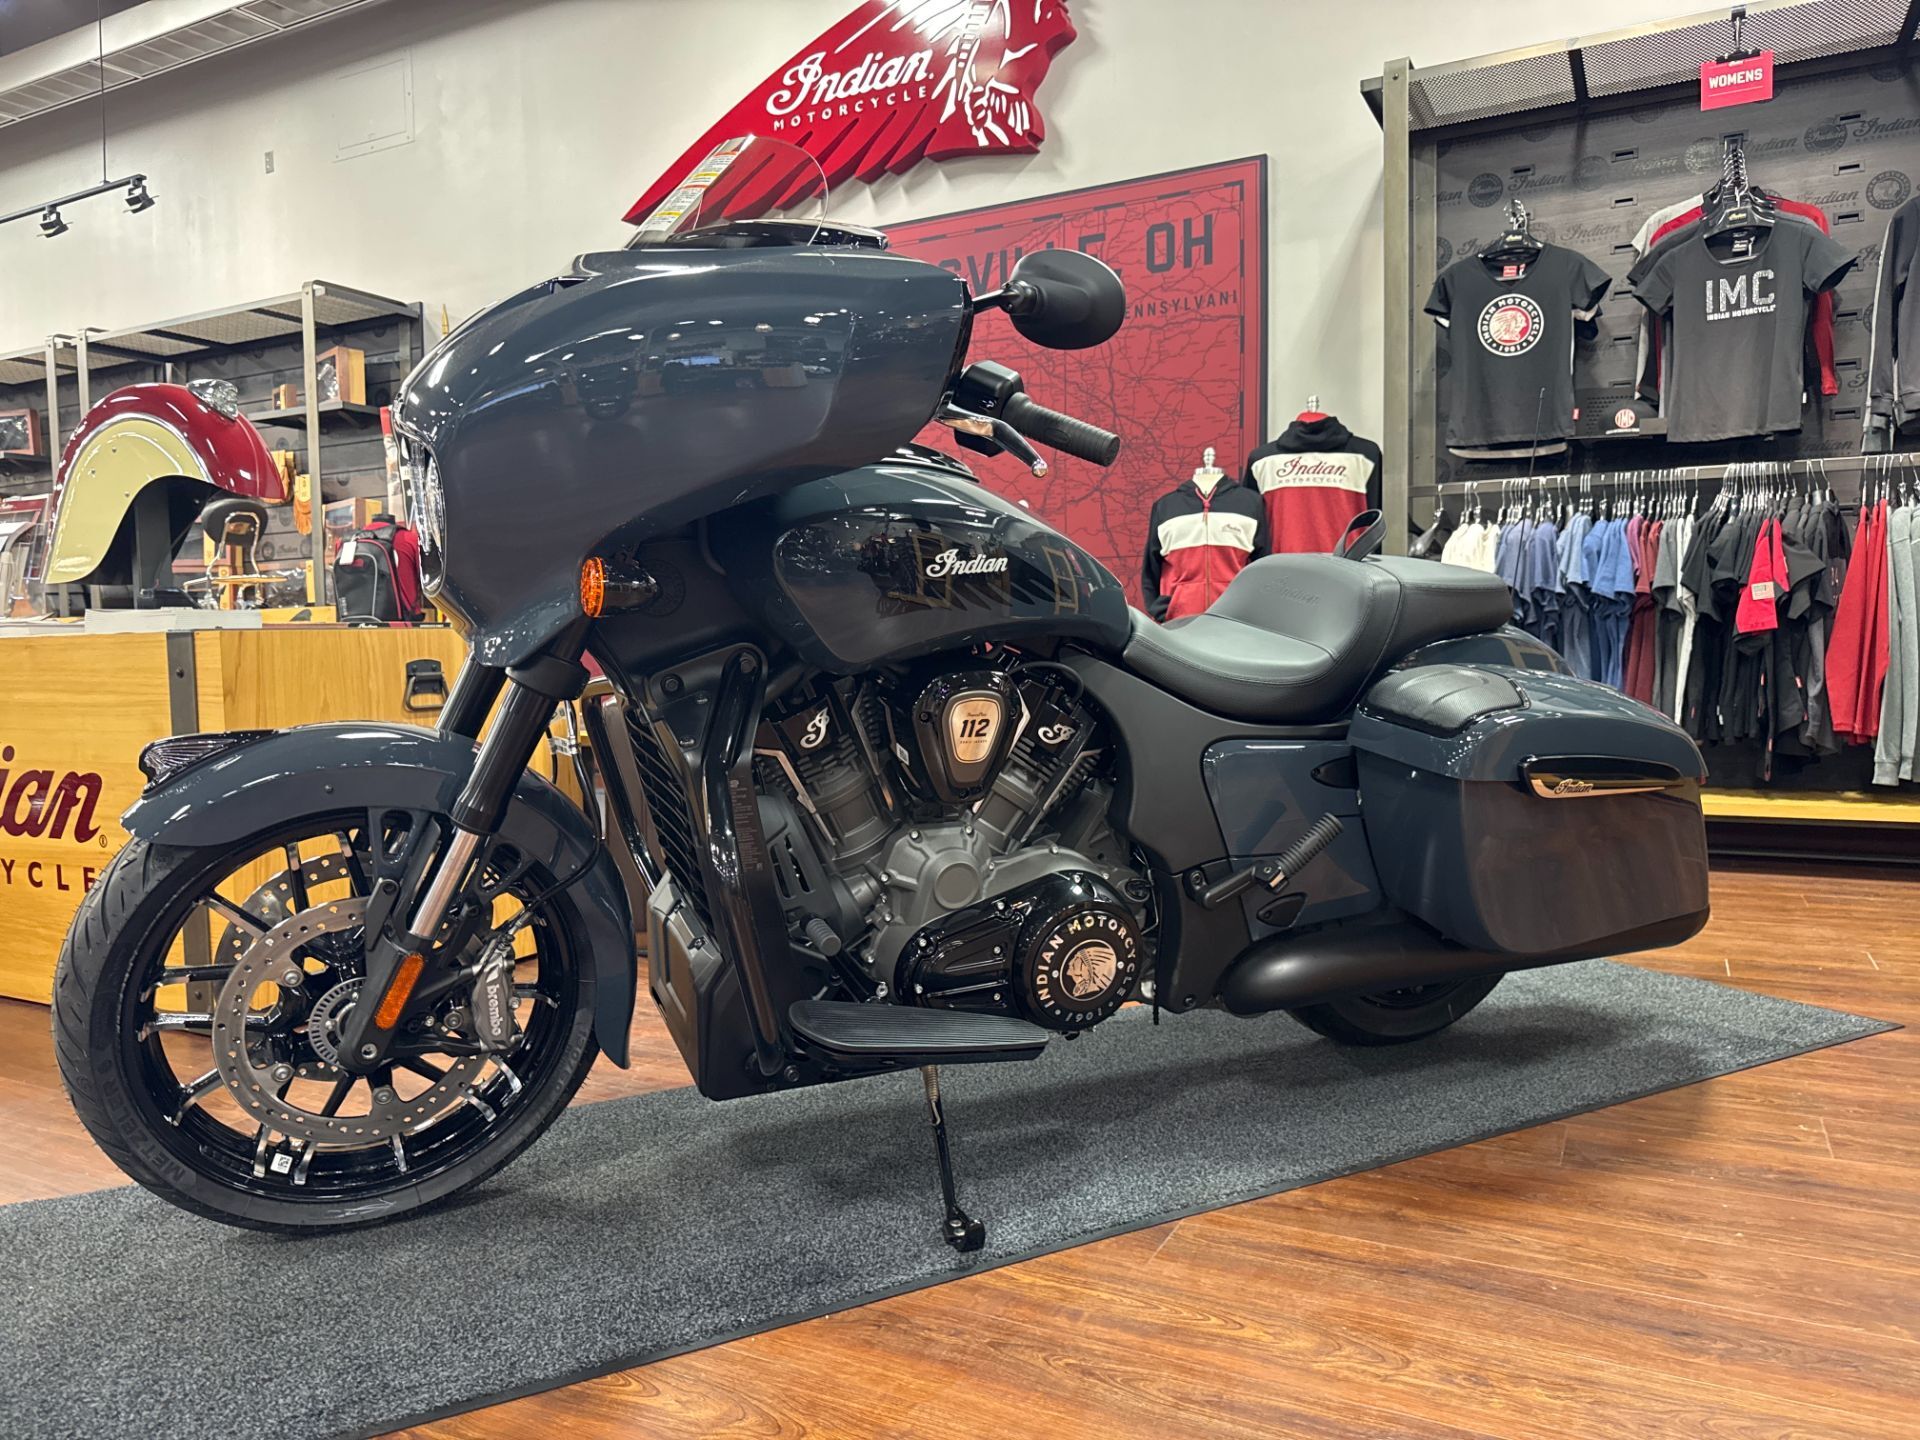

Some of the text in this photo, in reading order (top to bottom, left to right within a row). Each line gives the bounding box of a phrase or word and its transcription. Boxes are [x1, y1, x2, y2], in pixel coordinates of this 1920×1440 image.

[766, 50, 934, 115] Indian
[1709, 68, 1763, 88] WOMENS
[773, 86, 927, 131] MOTORCYCLE
[1147, 215, 1213, 273] OH
[1706, 269, 1775, 313] IMC
[1482, 298, 1540, 344] INDIAN MOTORCYCLE
[1707, 304, 1776, 321] INDIAN MOTORCYCLE
[1276, 456, 1347, 478] Indian
[926, 549, 1008, 577] Indian
[960, 718, 990, 737] 112
[1554, 778, 1593, 794] Indian
[1036, 915, 1136, 1008] INDIAN MOTORCYCLE
[487, 984, 503, 1036] brembo
[1065, 1008, 1102, 1022] 1901
